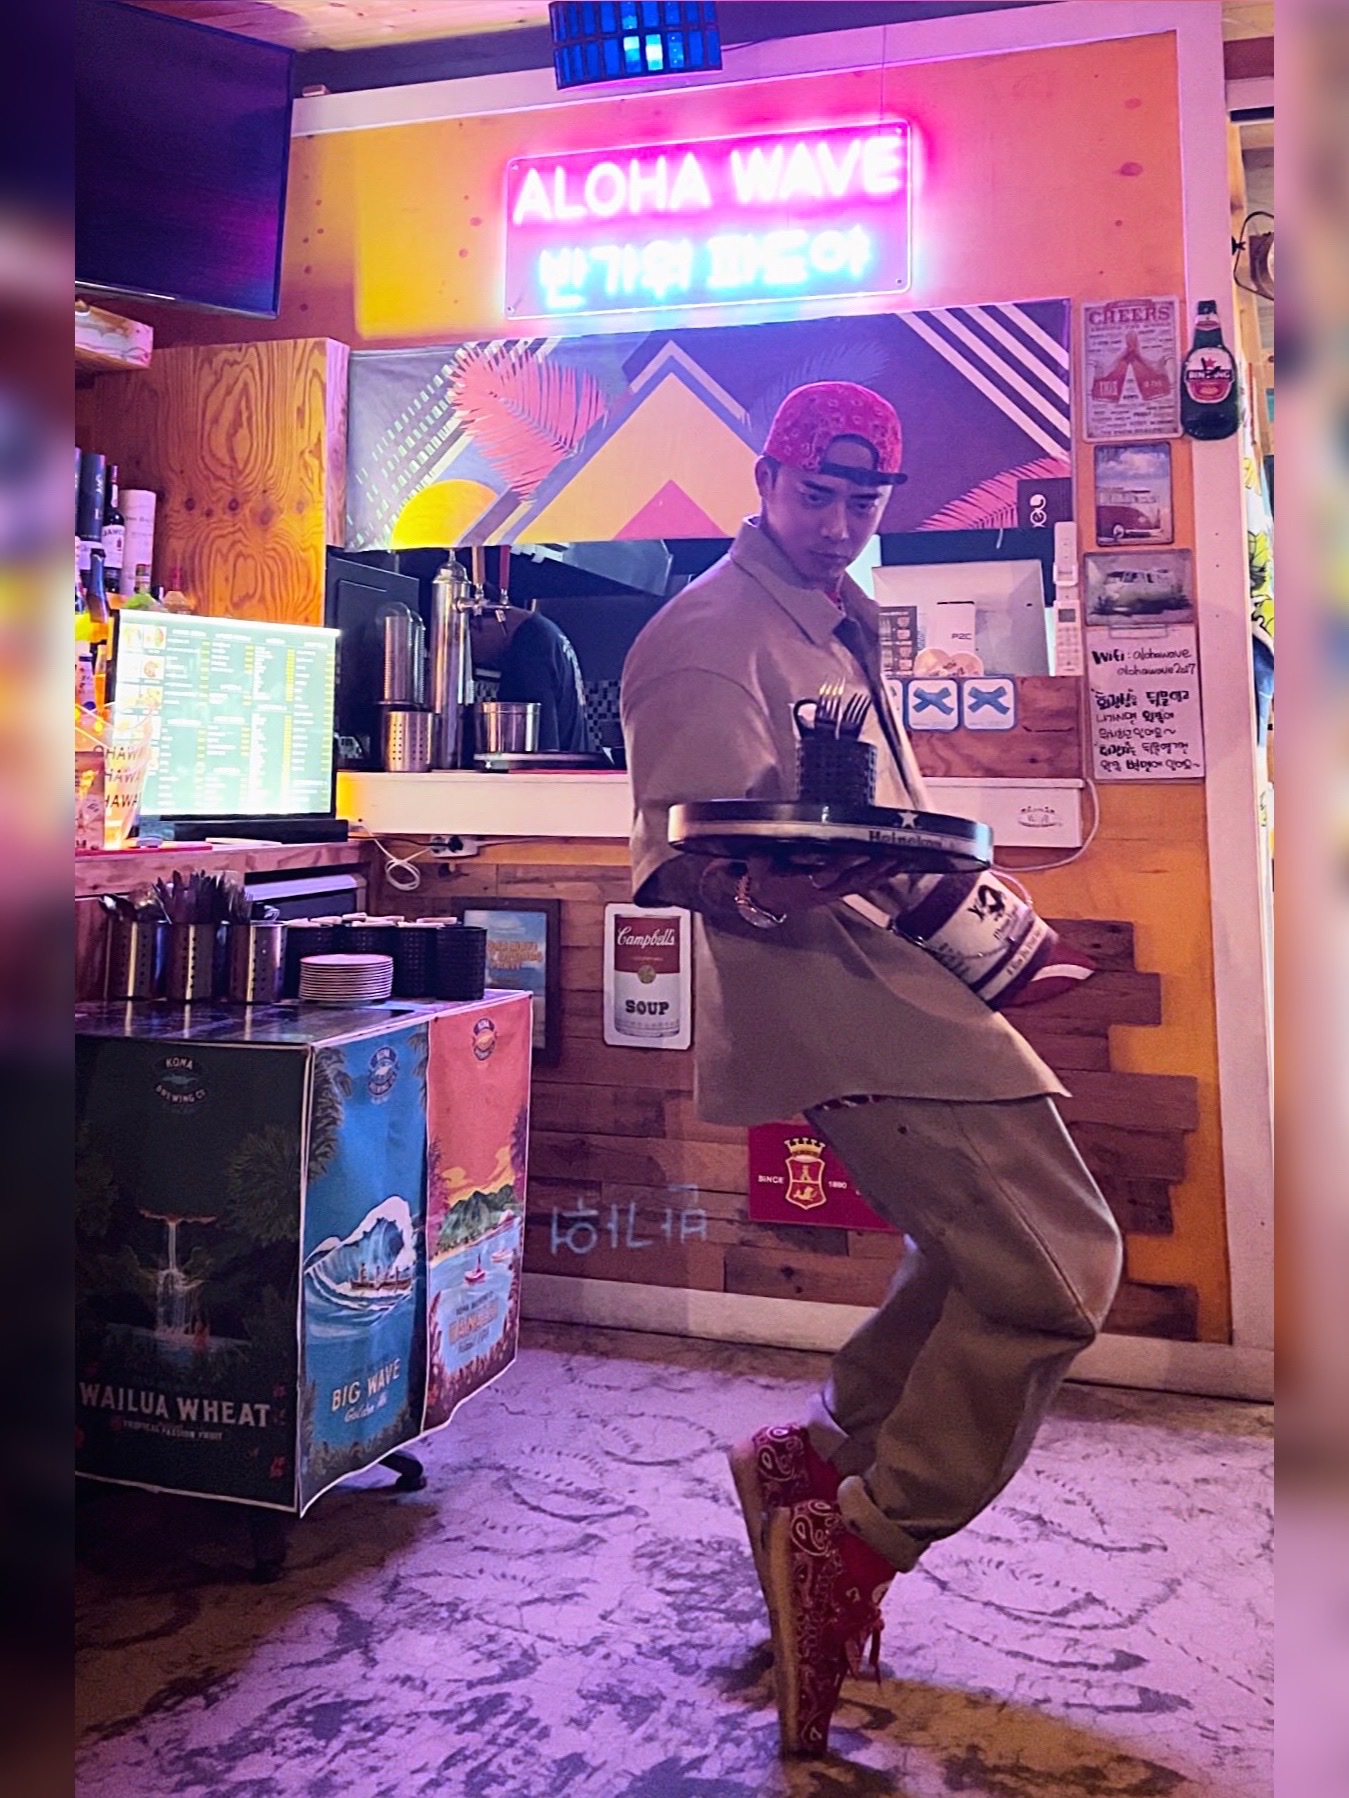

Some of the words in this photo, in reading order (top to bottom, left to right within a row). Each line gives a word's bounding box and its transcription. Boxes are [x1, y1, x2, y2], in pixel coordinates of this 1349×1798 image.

[512, 152, 711, 225] ALOHA
[729, 136, 901, 205] WAVE
[538, 237, 694, 309] 반가워
[706, 225, 871, 288] 파도야
[1088, 306, 1171, 325] CHEERS
[1133, 647, 1192, 660] alohawave
[625, 1000, 670, 1016] SOUP
[165, 1056, 193, 1071] KONA
[757, 1175, 784, 1185] SINCE
[332, 1381, 361, 1412] BIG
[367, 1358, 401, 1397] WAVE
[79, 1382, 170, 1420] WAILUA
[176, 1397, 271, 1428] WHEAT
